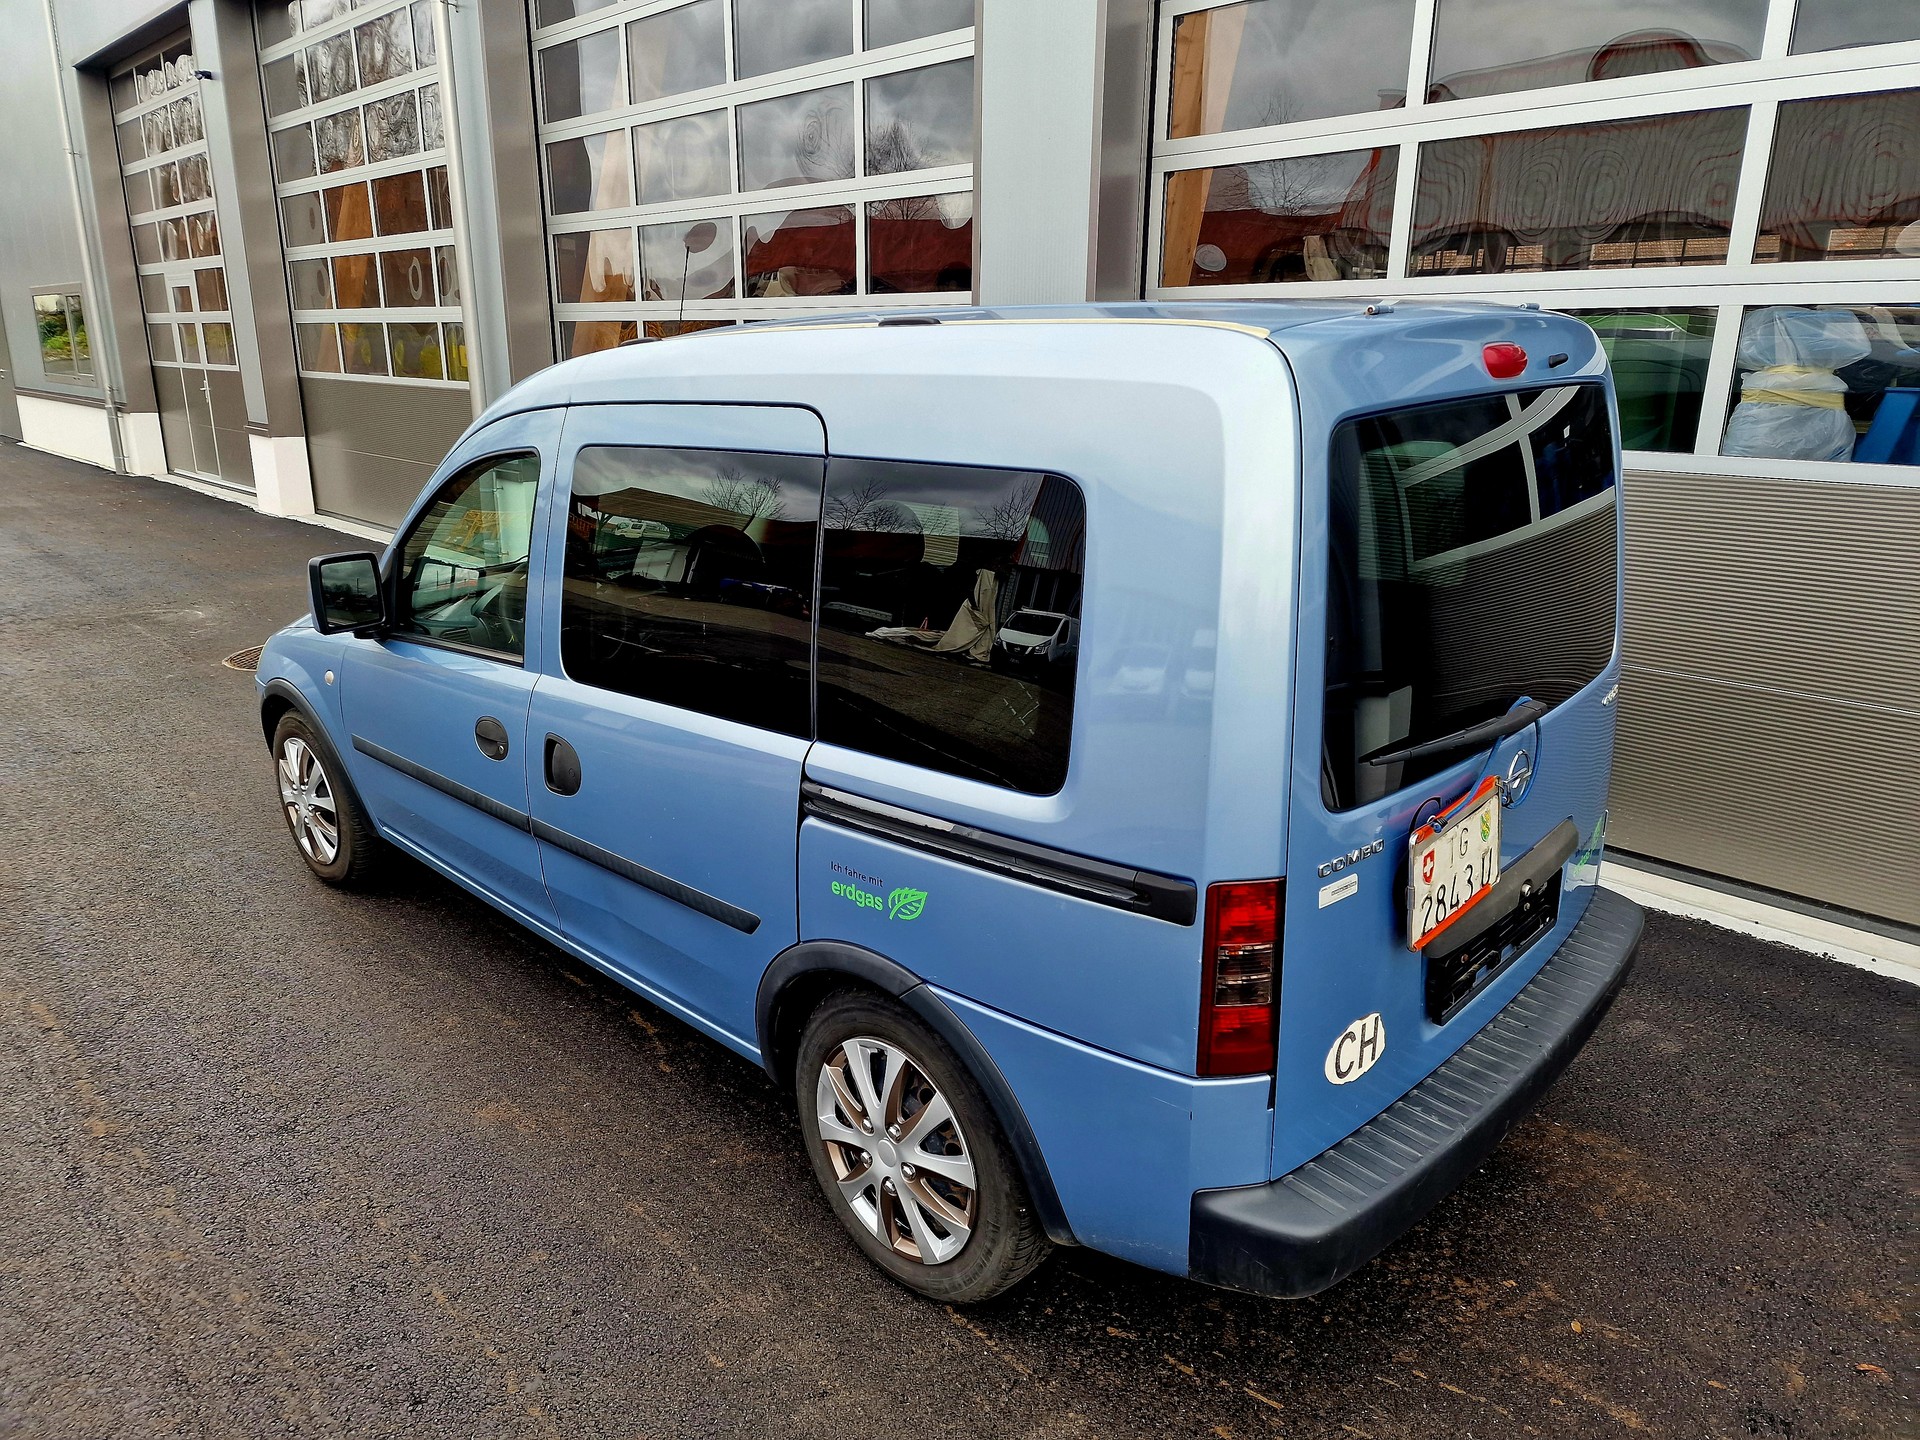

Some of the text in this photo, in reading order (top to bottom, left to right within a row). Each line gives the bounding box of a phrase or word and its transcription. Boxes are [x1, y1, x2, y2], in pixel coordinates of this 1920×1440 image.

[831, 861, 883, 887] Ich fahre mit
[1317, 838, 1385, 879] COMBO
[831, 881, 883, 911] erdgas
[1335, 1015, 1380, 1080] CH
